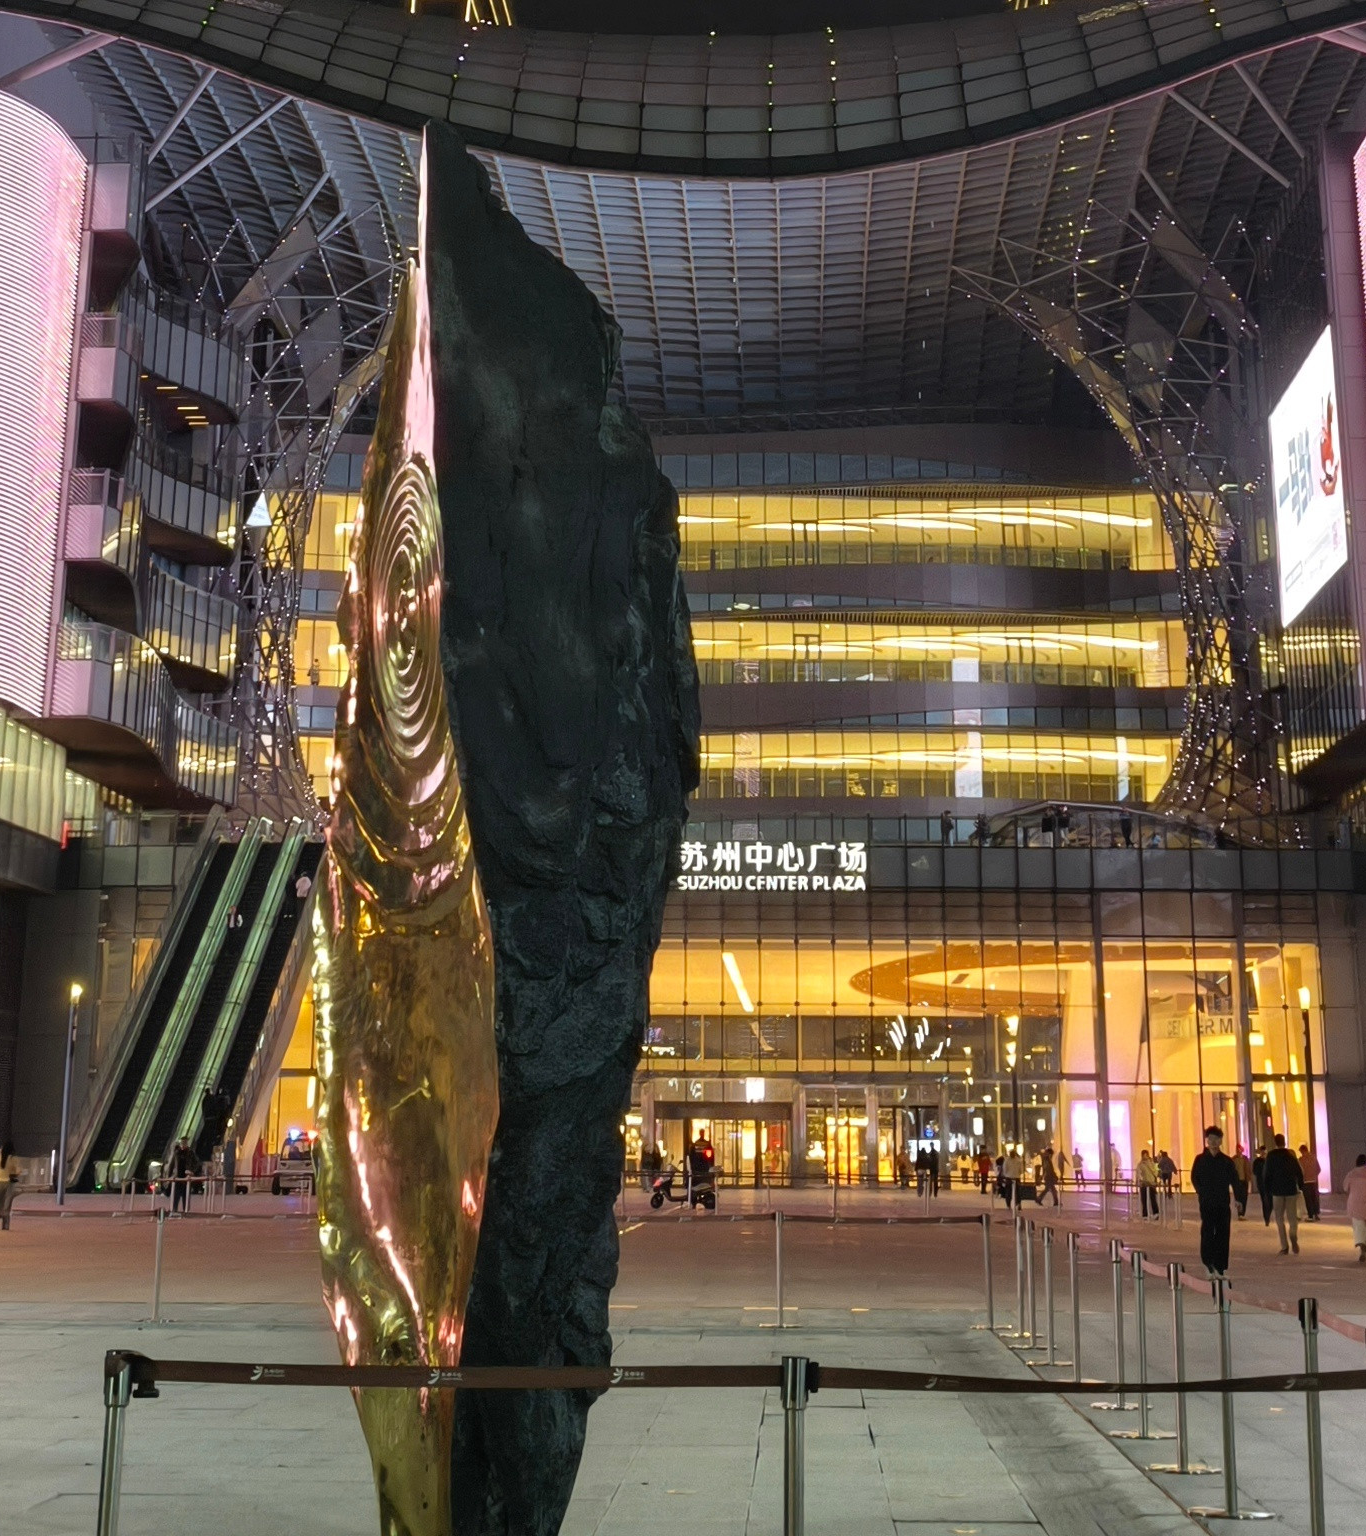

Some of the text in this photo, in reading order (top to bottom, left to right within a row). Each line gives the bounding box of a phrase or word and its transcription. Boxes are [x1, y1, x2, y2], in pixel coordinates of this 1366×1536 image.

[680, 841, 867, 872] 苏州中心广场
[677, 875, 867, 891] SUZHOU CENTER PLAZA
[1167, 1018, 1215, 1036] CEER
